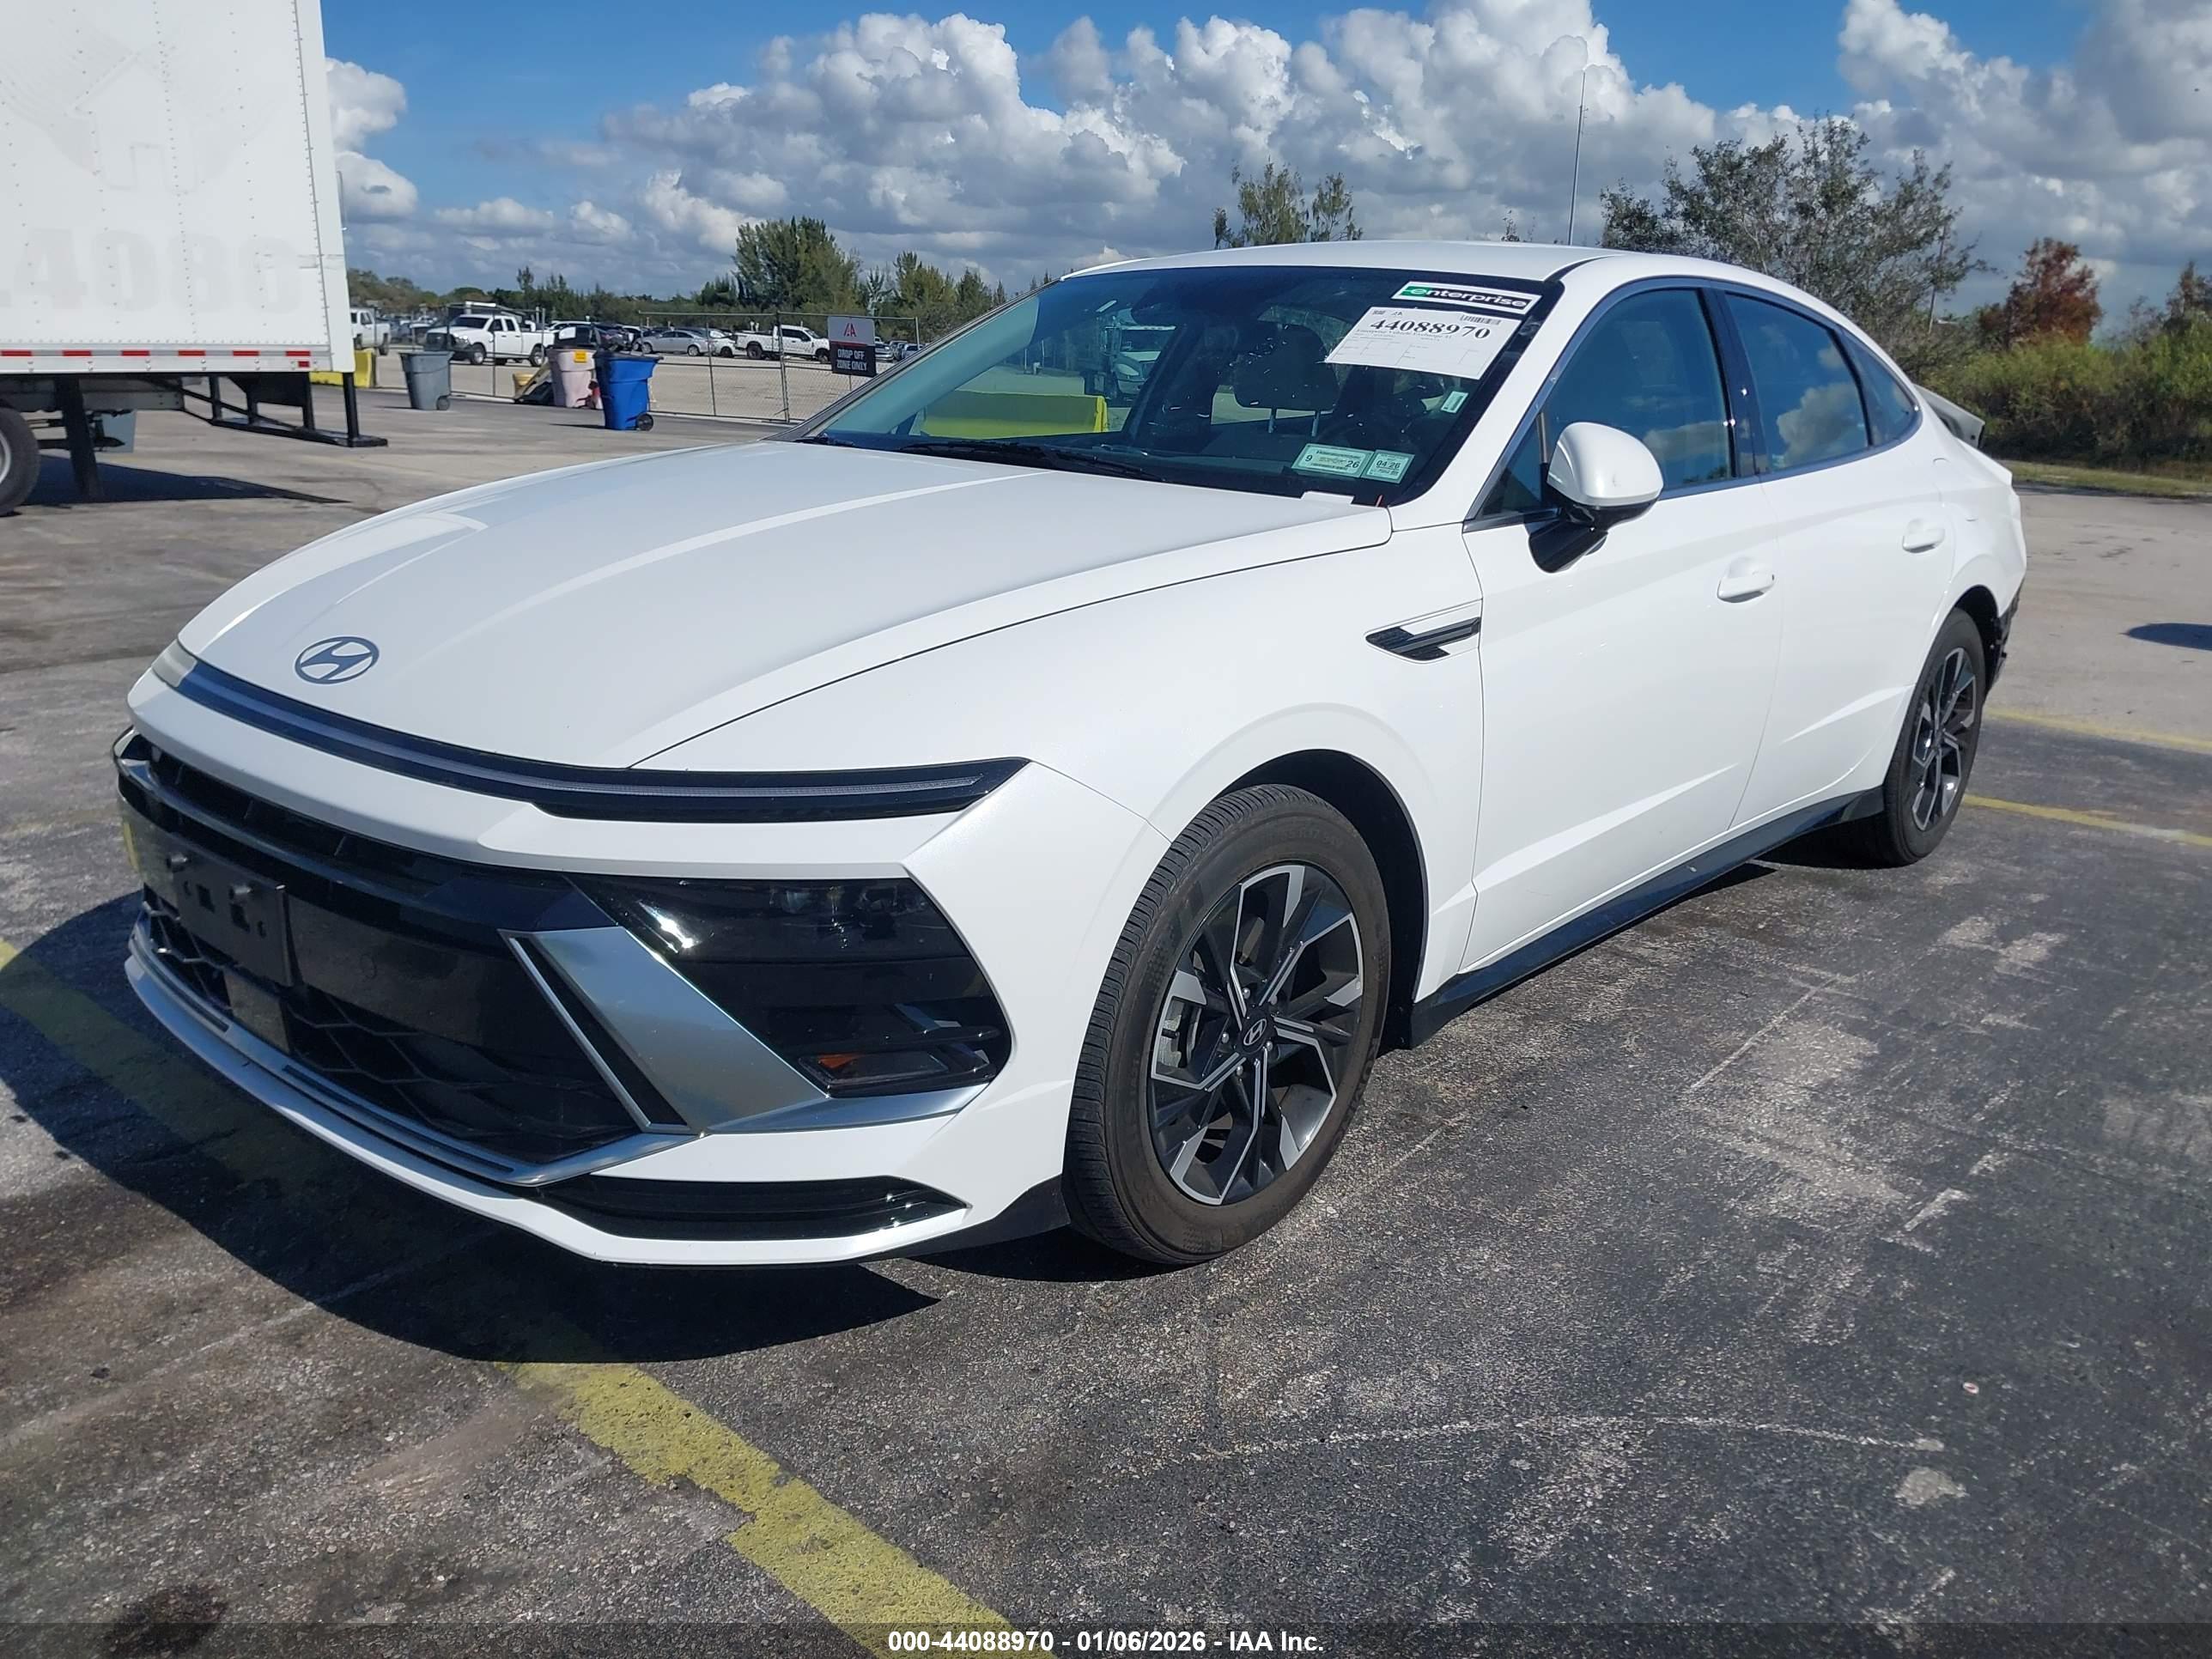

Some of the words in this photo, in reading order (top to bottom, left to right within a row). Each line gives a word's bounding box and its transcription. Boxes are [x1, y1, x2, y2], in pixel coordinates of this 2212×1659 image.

[1407, 287, 1528, 307] enterprise
[1370, 319, 1491, 340] 44088970
[837, 349, 853, 359] DROP
[854, 349, 866, 360] OFF
[836, 360, 851, 369] ZONE
[851, 361, 867, 371] ONLY
[1346, 459, 1360, 469] 26
